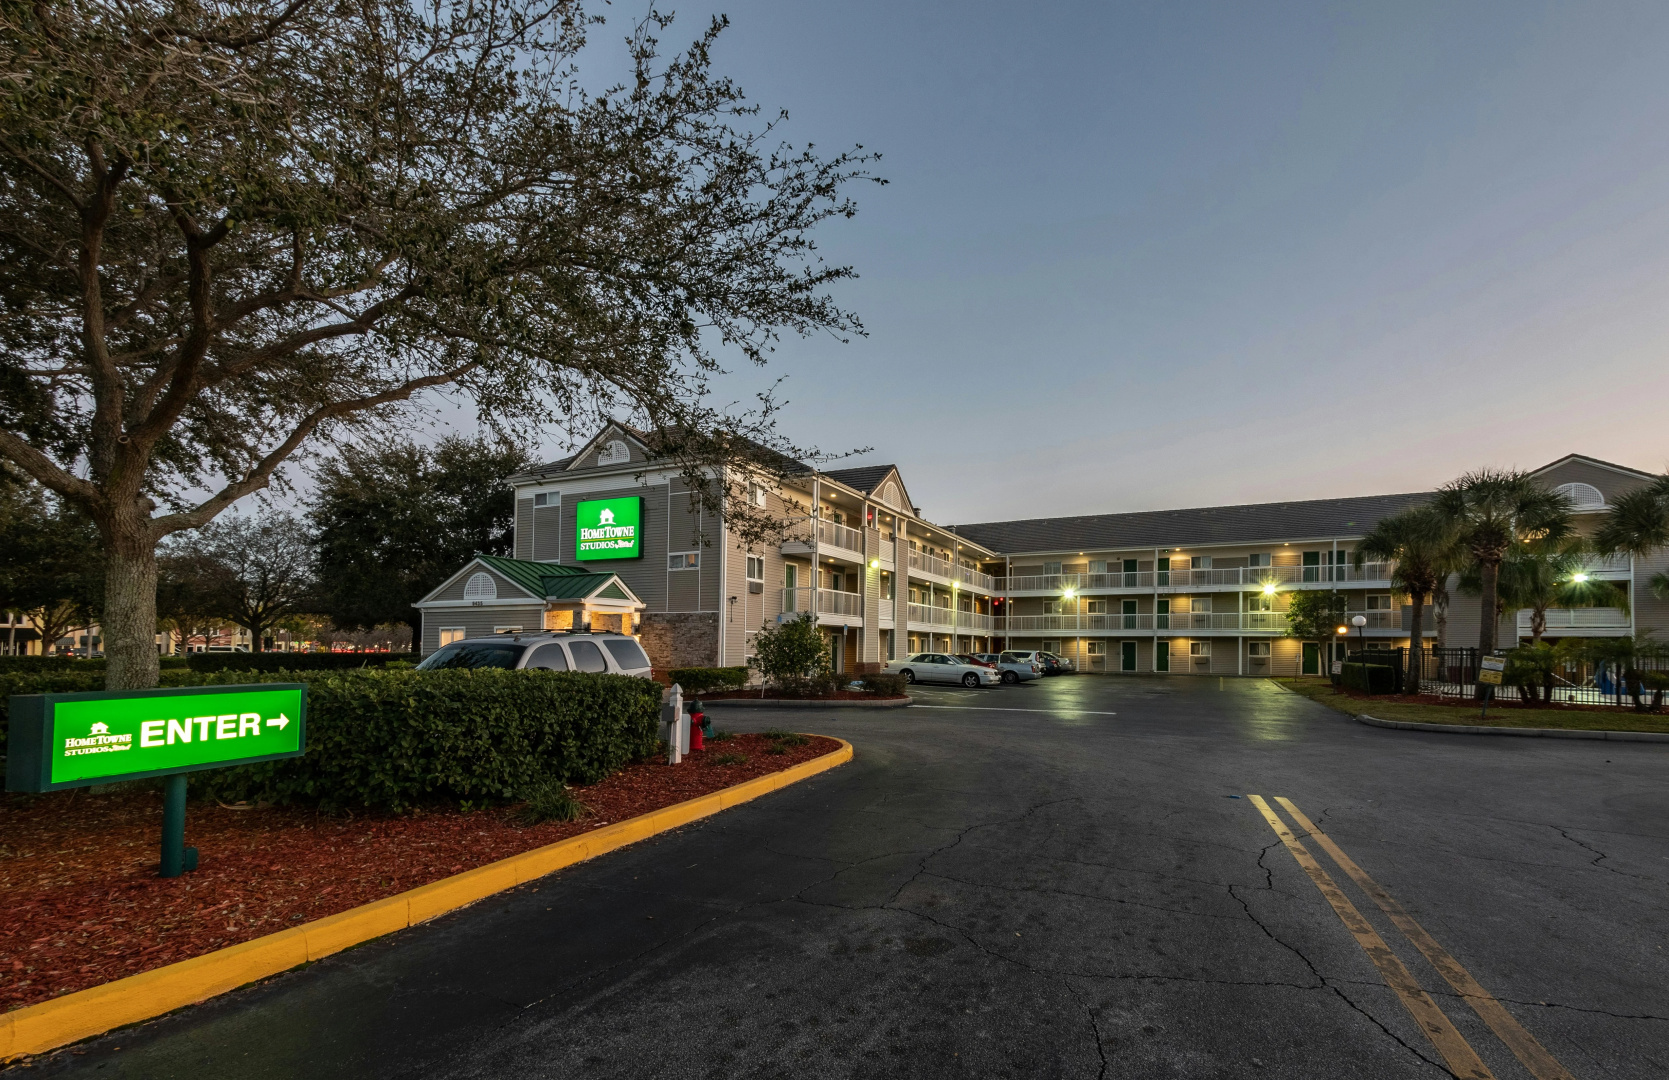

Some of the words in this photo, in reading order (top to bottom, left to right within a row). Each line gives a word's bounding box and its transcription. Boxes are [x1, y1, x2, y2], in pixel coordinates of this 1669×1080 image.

[581, 541, 615, 551] STUDIOS
[140, 712, 261, 748] ENTER
[64, 746, 109, 756] STUDIOS
